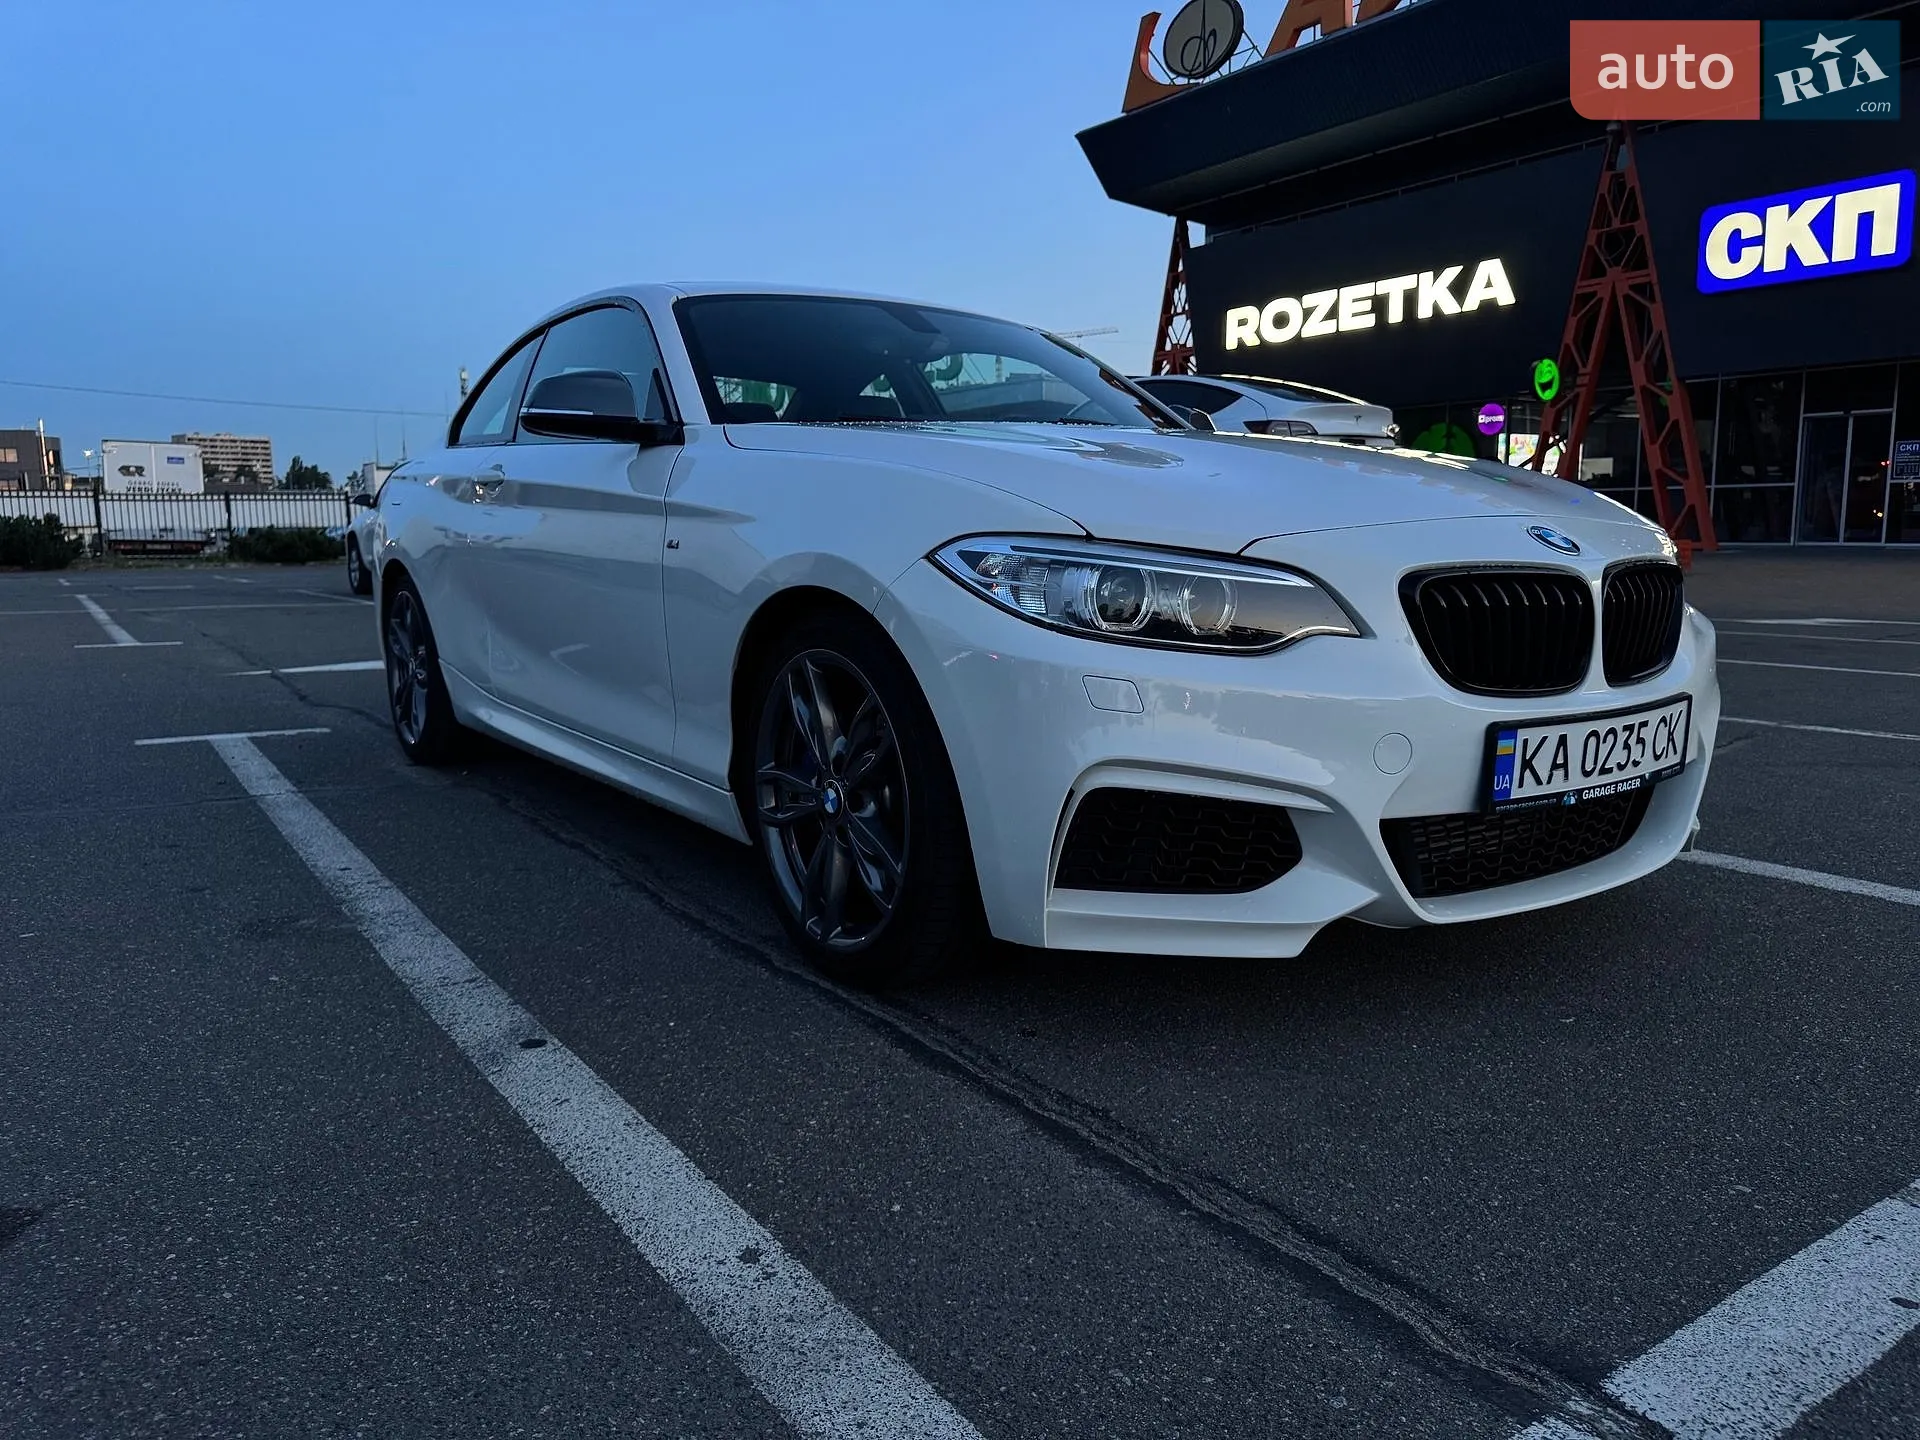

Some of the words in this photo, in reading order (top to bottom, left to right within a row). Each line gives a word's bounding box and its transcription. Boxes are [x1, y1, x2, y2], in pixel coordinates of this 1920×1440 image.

[1705, 182, 1902, 281] СКП
[1225, 257, 1516, 351] ROZETKA
[1899, 443, 1920, 452] СКП
[1517, 732, 1570, 789] KA
[1580, 719, 1650, 778] 0235
[1652, 709, 1683, 762] CK
[1494, 774, 1511, 791] UA
[1582, 785, 1617, 800] GARAGE
[1616, 778, 1641, 793] RACER
